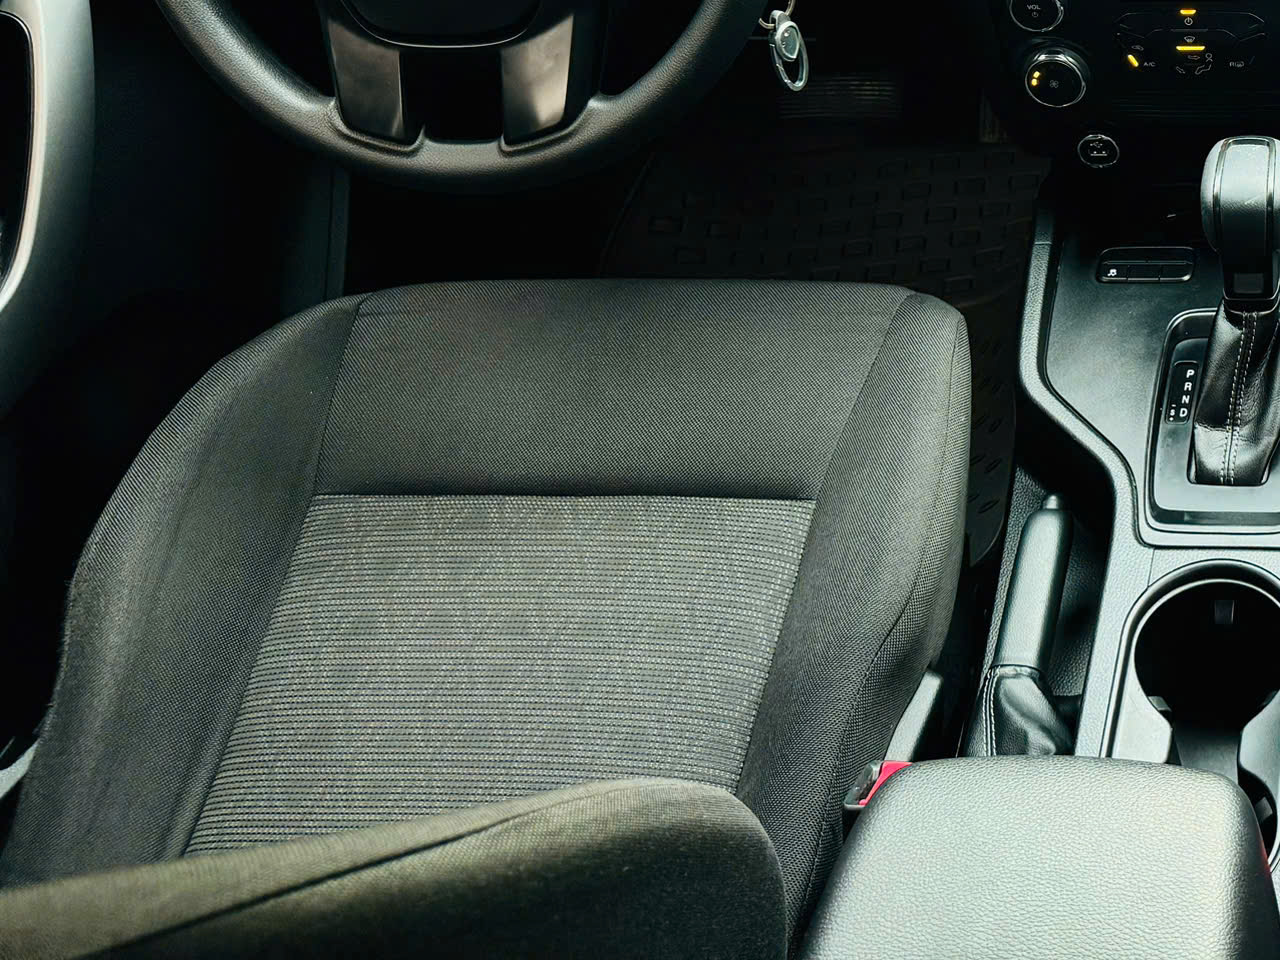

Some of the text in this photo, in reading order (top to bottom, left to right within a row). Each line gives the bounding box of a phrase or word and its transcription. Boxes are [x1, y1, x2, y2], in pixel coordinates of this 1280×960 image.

[1186, 369, 1195, 379] P
[1184, 381, 1193, 391] R
[1181, 394, 1190, 404] N
[1179, 407, 1188, 417] D
